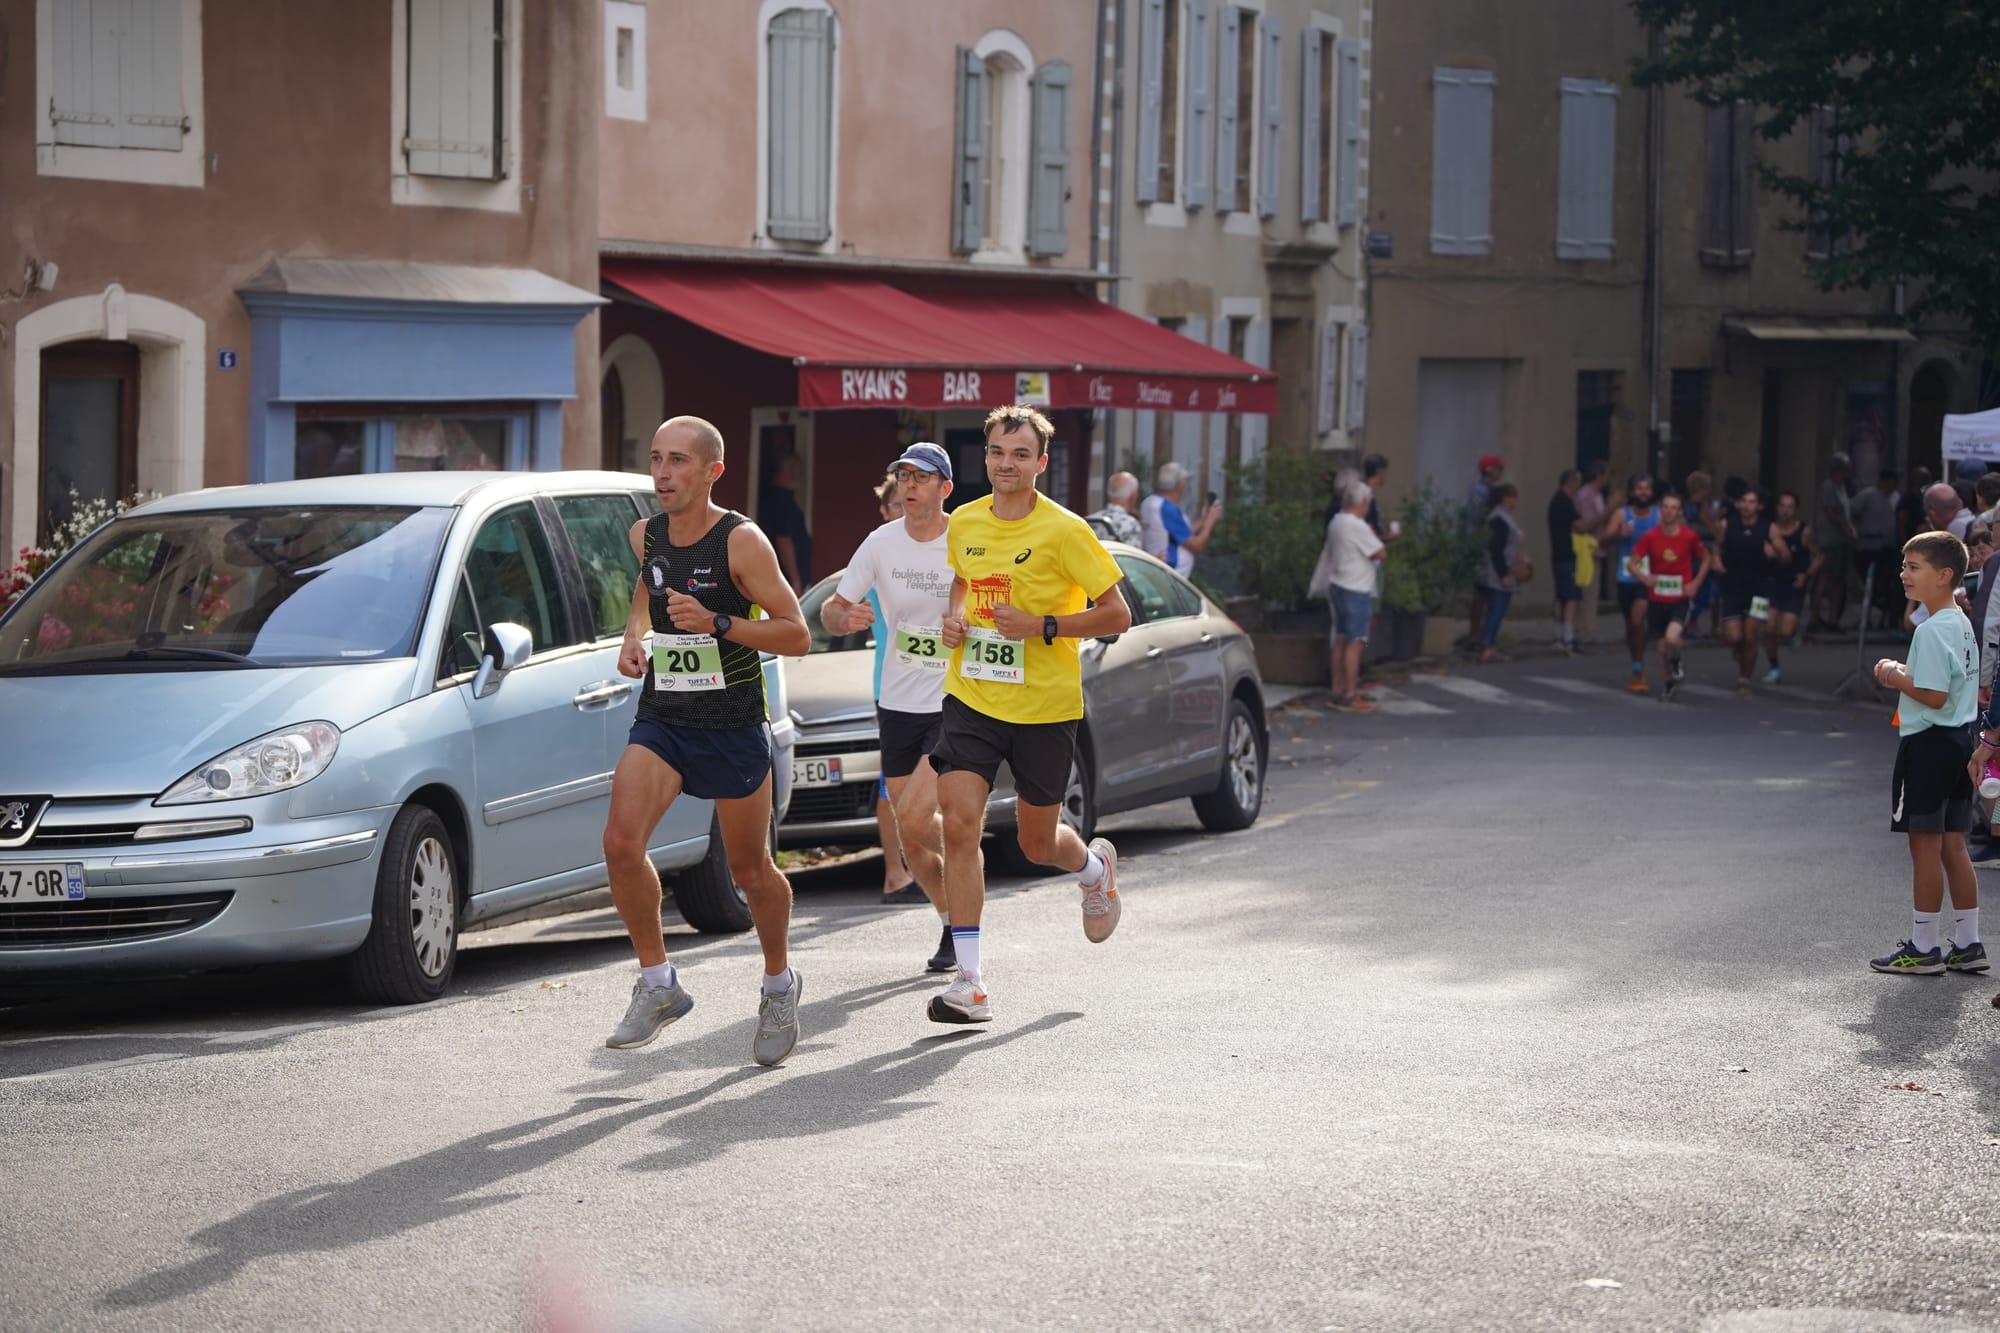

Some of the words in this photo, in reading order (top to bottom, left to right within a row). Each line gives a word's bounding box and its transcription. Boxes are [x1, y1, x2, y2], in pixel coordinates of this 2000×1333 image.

[841, 368, 908, 401] RYAN'S
[942, 371, 982, 402] BAR
[1089, 375, 1113, 402] Chez
[891, 567, 924, 580] foulées
[926, 569, 939, 581] de
[906, 577, 950, 592] l'éléphan
[908, 637, 936, 656] 23
[972, 641, 1014, 665] 158
[667, 650, 700, 672] 20
[69, 881, 82, 894] 59
